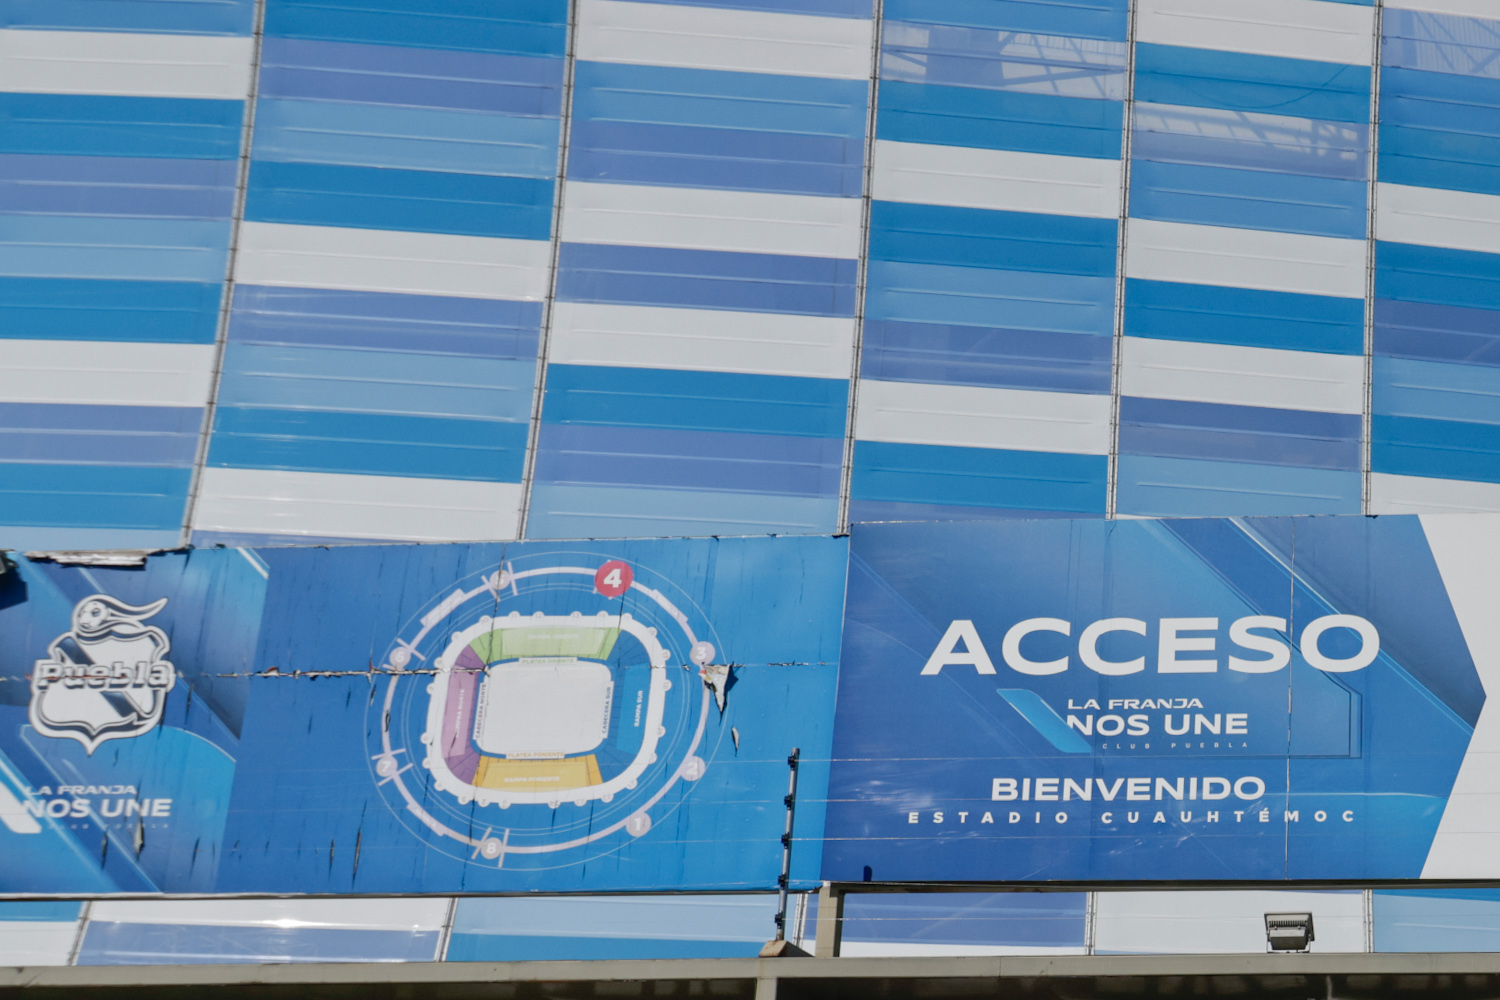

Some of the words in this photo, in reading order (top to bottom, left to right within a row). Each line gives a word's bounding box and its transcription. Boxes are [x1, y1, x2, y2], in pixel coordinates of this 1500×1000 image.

[603, 568, 622, 588] 4
[920, 614, 1380, 676] ACCESO
[395, 651, 405, 663] 6
[696, 647, 706, 660] 3
[37, 662, 170, 690] Puebla
[1067, 698, 1100, 709] LA
[1108, 697, 1204, 709] FRANJA
[634, 704, 643, 727] RAMPA
[1066, 714, 1149, 736] NOS
[1165, 713, 1249, 735] UNE
[382, 761, 391, 773] 7
[686, 762, 699, 775] 2
[25, 785, 52, 796] LA
[57, 784, 138, 795] FRANJA
[991, 776, 1265, 801] BIENVENIDO
[22, 799, 91, 818] NOS
[101, 798, 172, 818] UNE
[908, 811, 1068, 824] ESTADIO
[1101, 807, 1356, 824] CUAUHTÉMOC
[634, 817, 642, 831] 1
[487, 842, 496, 854] 8
